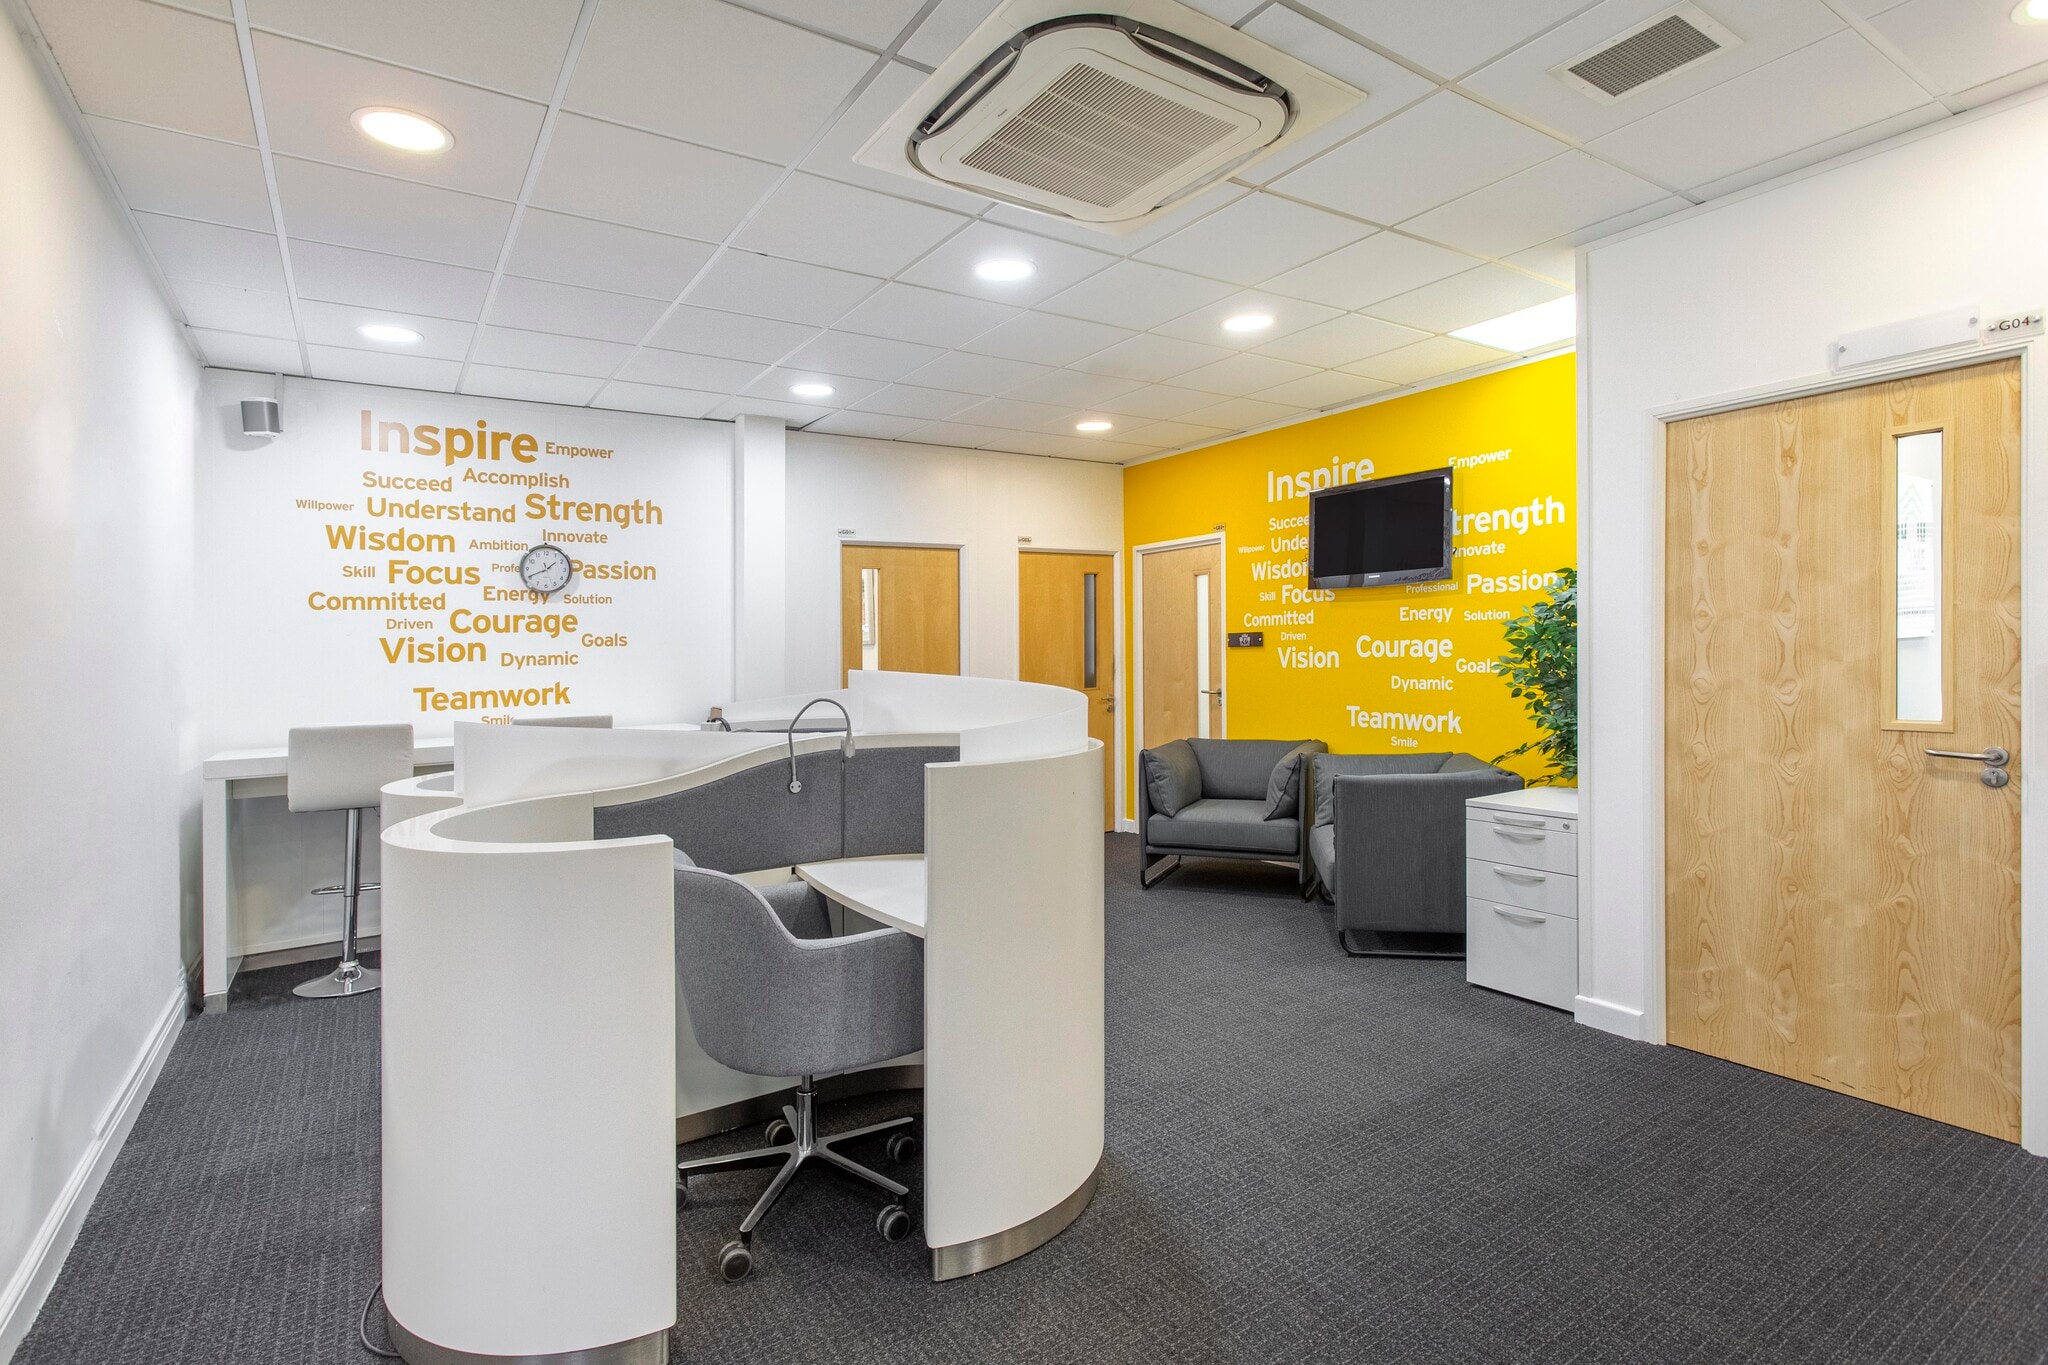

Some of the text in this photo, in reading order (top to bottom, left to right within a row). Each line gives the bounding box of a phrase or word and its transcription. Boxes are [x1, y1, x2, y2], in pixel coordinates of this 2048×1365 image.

[1999, 316, 2030, 331] G04
[360, 409, 539, 467] Inspire
[545, 442, 614, 459] Empower
[1448, 449, 1512, 469] Empower
[362, 471, 453, 492] Succeed
[463, 468, 570, 488] Accomplish
[1267, 456, 1375, 503] Inspire
[295, 499, 355, 512] Willpower
[366, 497, 516, 523] Understand
[524, 493, 663, 530] Strength
[1268, 514, 1309, 531] Succee
[1453, 496, 1565, 535] trength
[325, 524, 456, 552] Wisdom
[468, 539, 529, 551] Ambition
[542, 529, 608, 544] Innovate
[1238, 544, 1265, 554] Willpower
[343, 565, 376, 577] Skill
[388, 559, 481, 585] Focus
[483, 585, 549, 605] Energy
[1259, 591, 1276, 602] Skill
[1281, 584, 1336, 604] Focus
[1406, 582, 1459, 593] Professional
[308, 591, 447, 611] Committed
[564, 594, 612, 604] Solution
[449, 608, 579, 639] Courage
[1243, 609, 1314, 627] Committed
[1400, 607, 1452, 622] Energy
[1464, 610, 1510, 620] Solution
[386, 618, 433, 630] Driven
[580, 633, 628, 648] Goals
[1280, 631, 1307, 641] Driven
[379, 636, 487, 664] Vision
[1277, 646, 1340, 669] Vision
[1357, 635, 1453, 663] Courage
[500, 652, 578, 669] Dynamic
[1391, 675, 1453, 692] Dynamic
[412, 681, 571, 712] Teamwork
[1346, 705, 1462, 734] Teamwork
[1391, 736, 1419, 748] Smile
